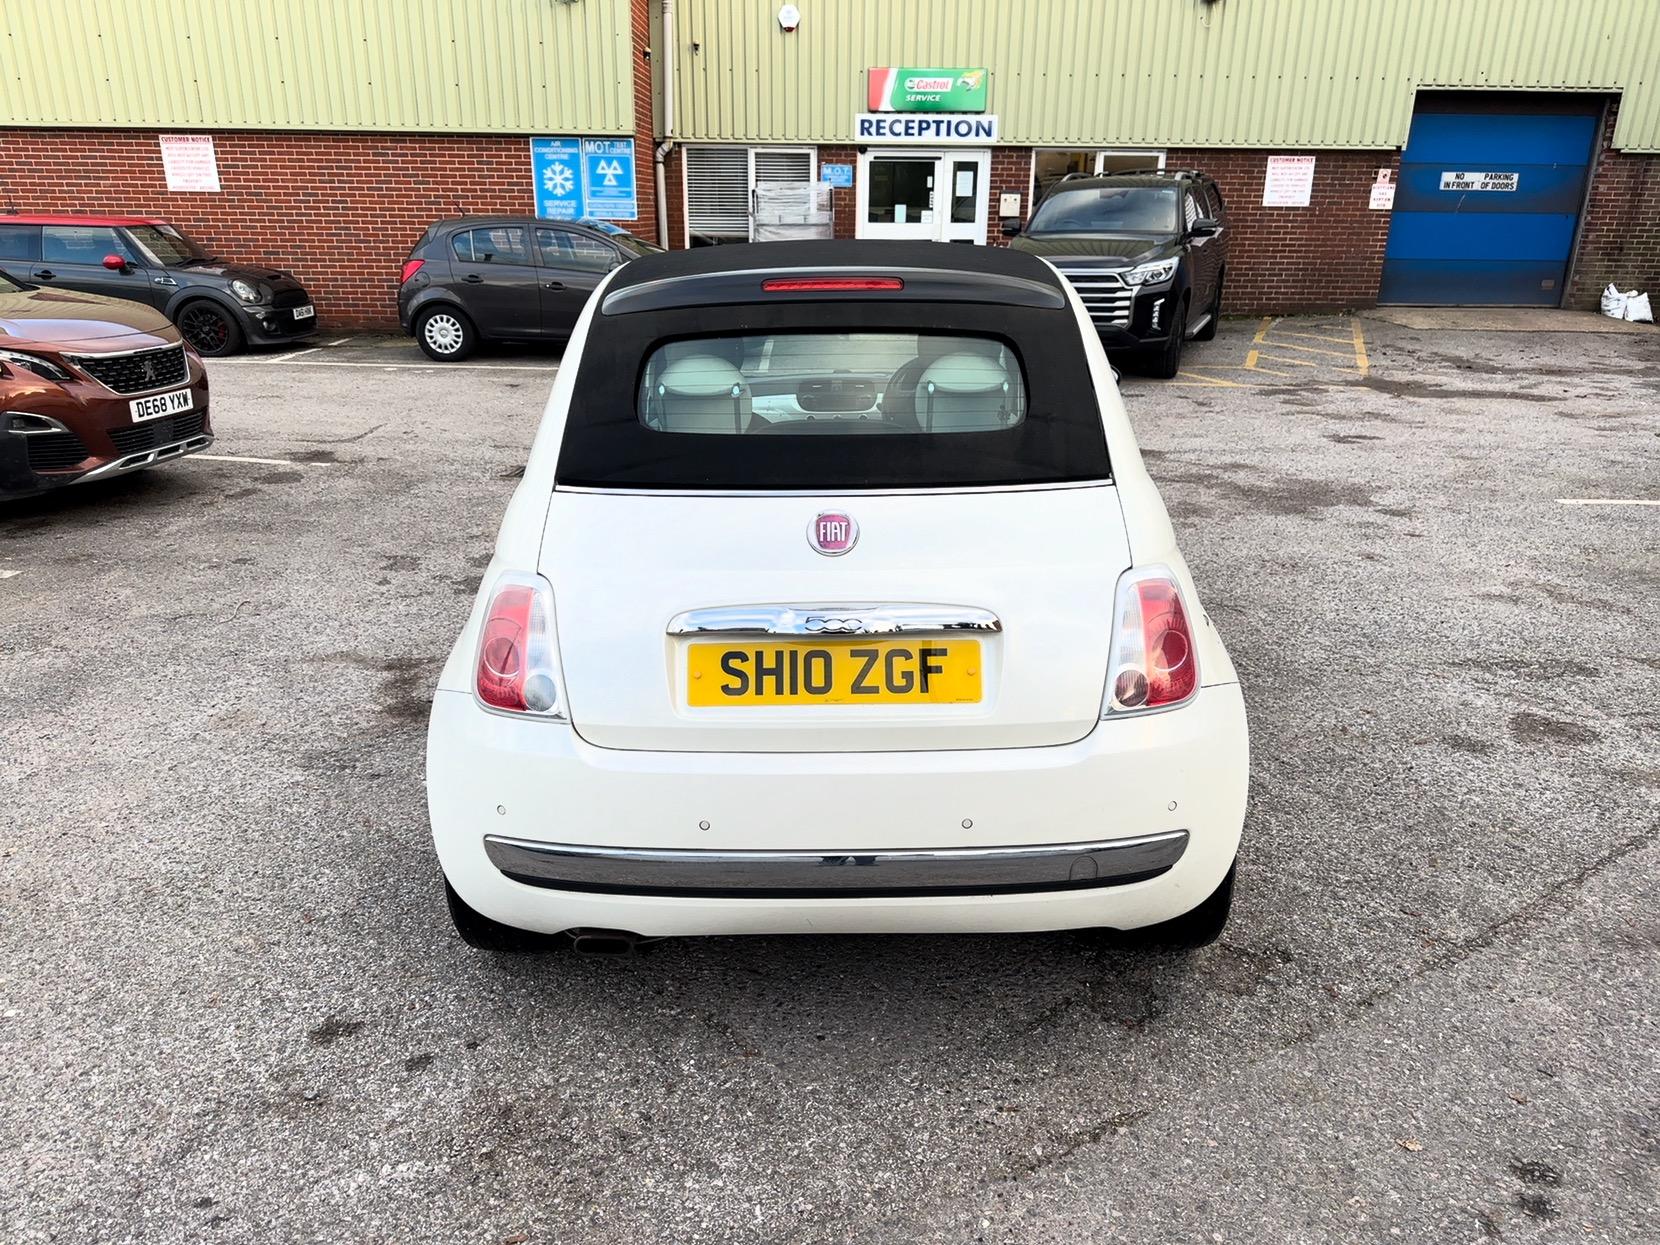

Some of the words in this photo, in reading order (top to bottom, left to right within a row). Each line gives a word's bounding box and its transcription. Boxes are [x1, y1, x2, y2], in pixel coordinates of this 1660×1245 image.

[916, 80, 949, 90] Castrol
[860, 119, 992, 138] RECEPTION
[585, 141, 611, 153] MOT
[1484, 173, 1514, 181] PARKING
[1491, 182, 1514, 190] DOORS
[136, 397, 167, 418] DE68
[169, 391, 189, 410] YXW
[820, 521, 848, 541] FIAT
[805, 616, 862, 631] 500
[720, 650, 832, 696] SH10
[850, 648, 948, 694] ZGF
